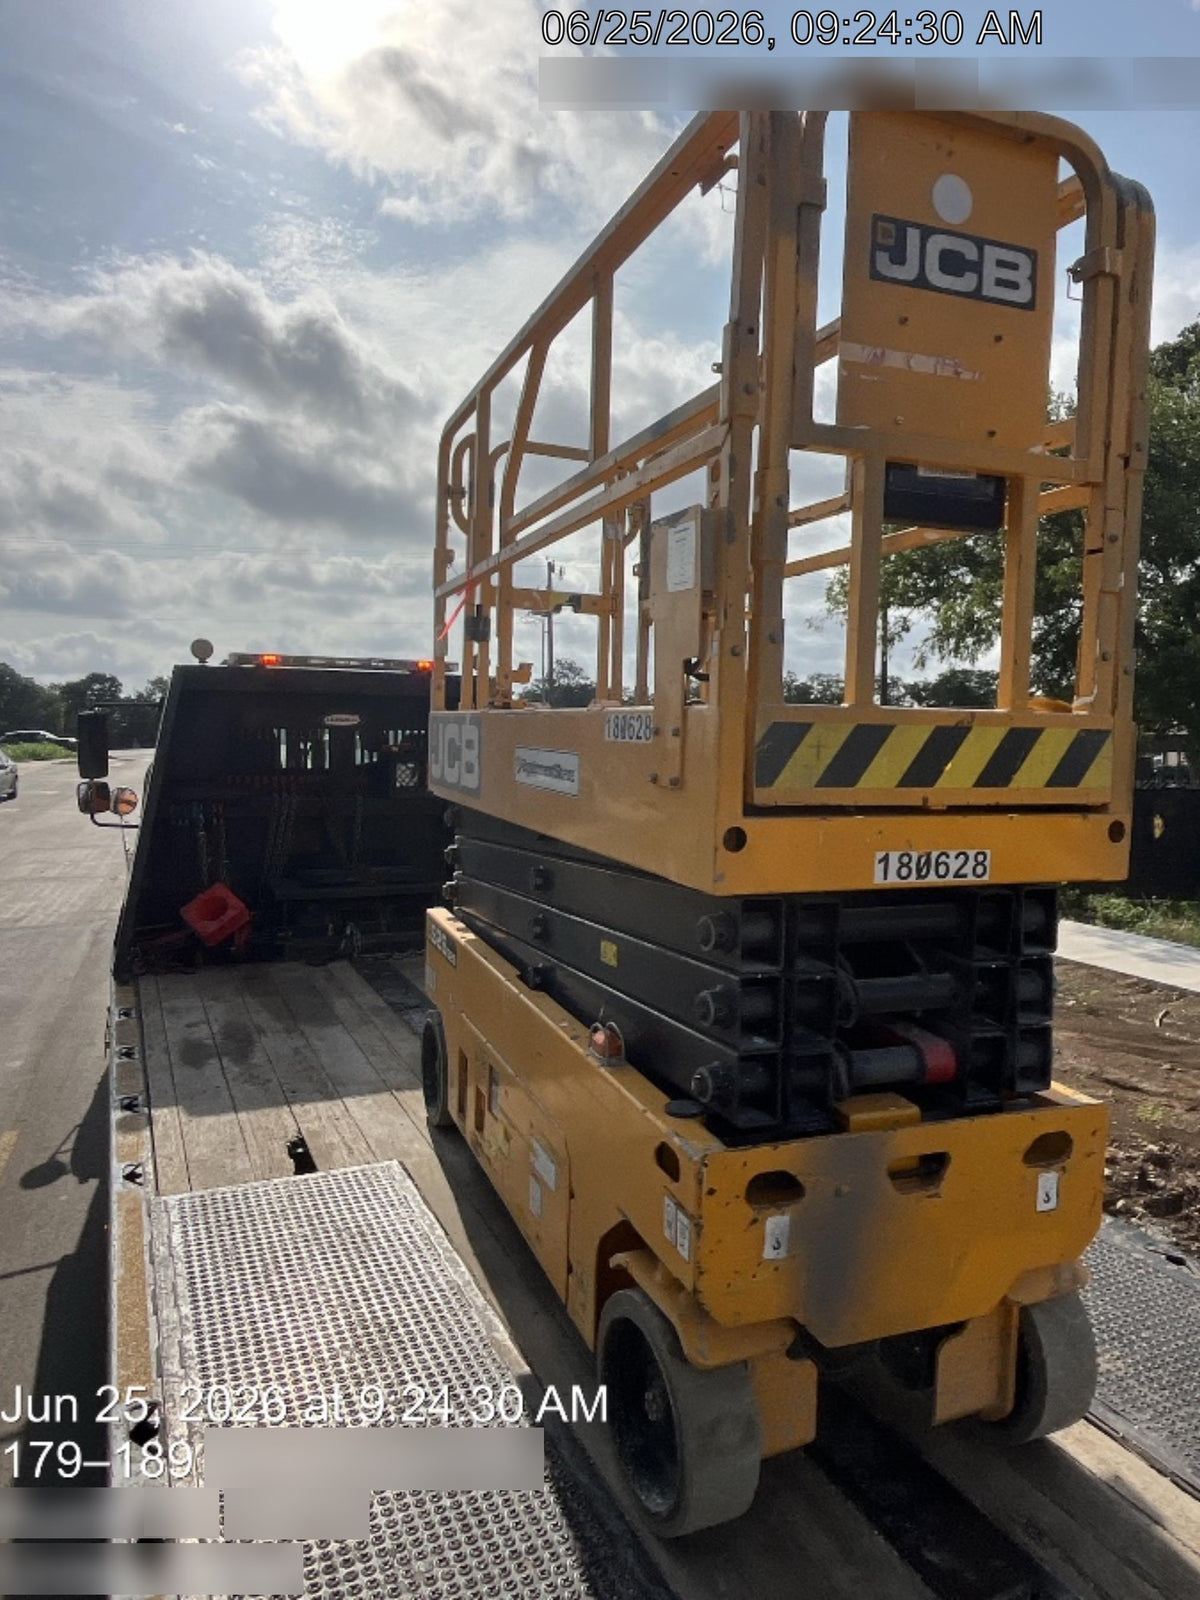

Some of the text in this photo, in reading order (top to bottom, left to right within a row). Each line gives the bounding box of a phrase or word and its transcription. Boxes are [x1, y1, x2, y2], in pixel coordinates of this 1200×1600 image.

[876, 227, 1032, 303] JCB
[607, 714, 651, 741] 180628
[431, 722, 479, 789] JCB
[877, 851, 988, 881] 180628
